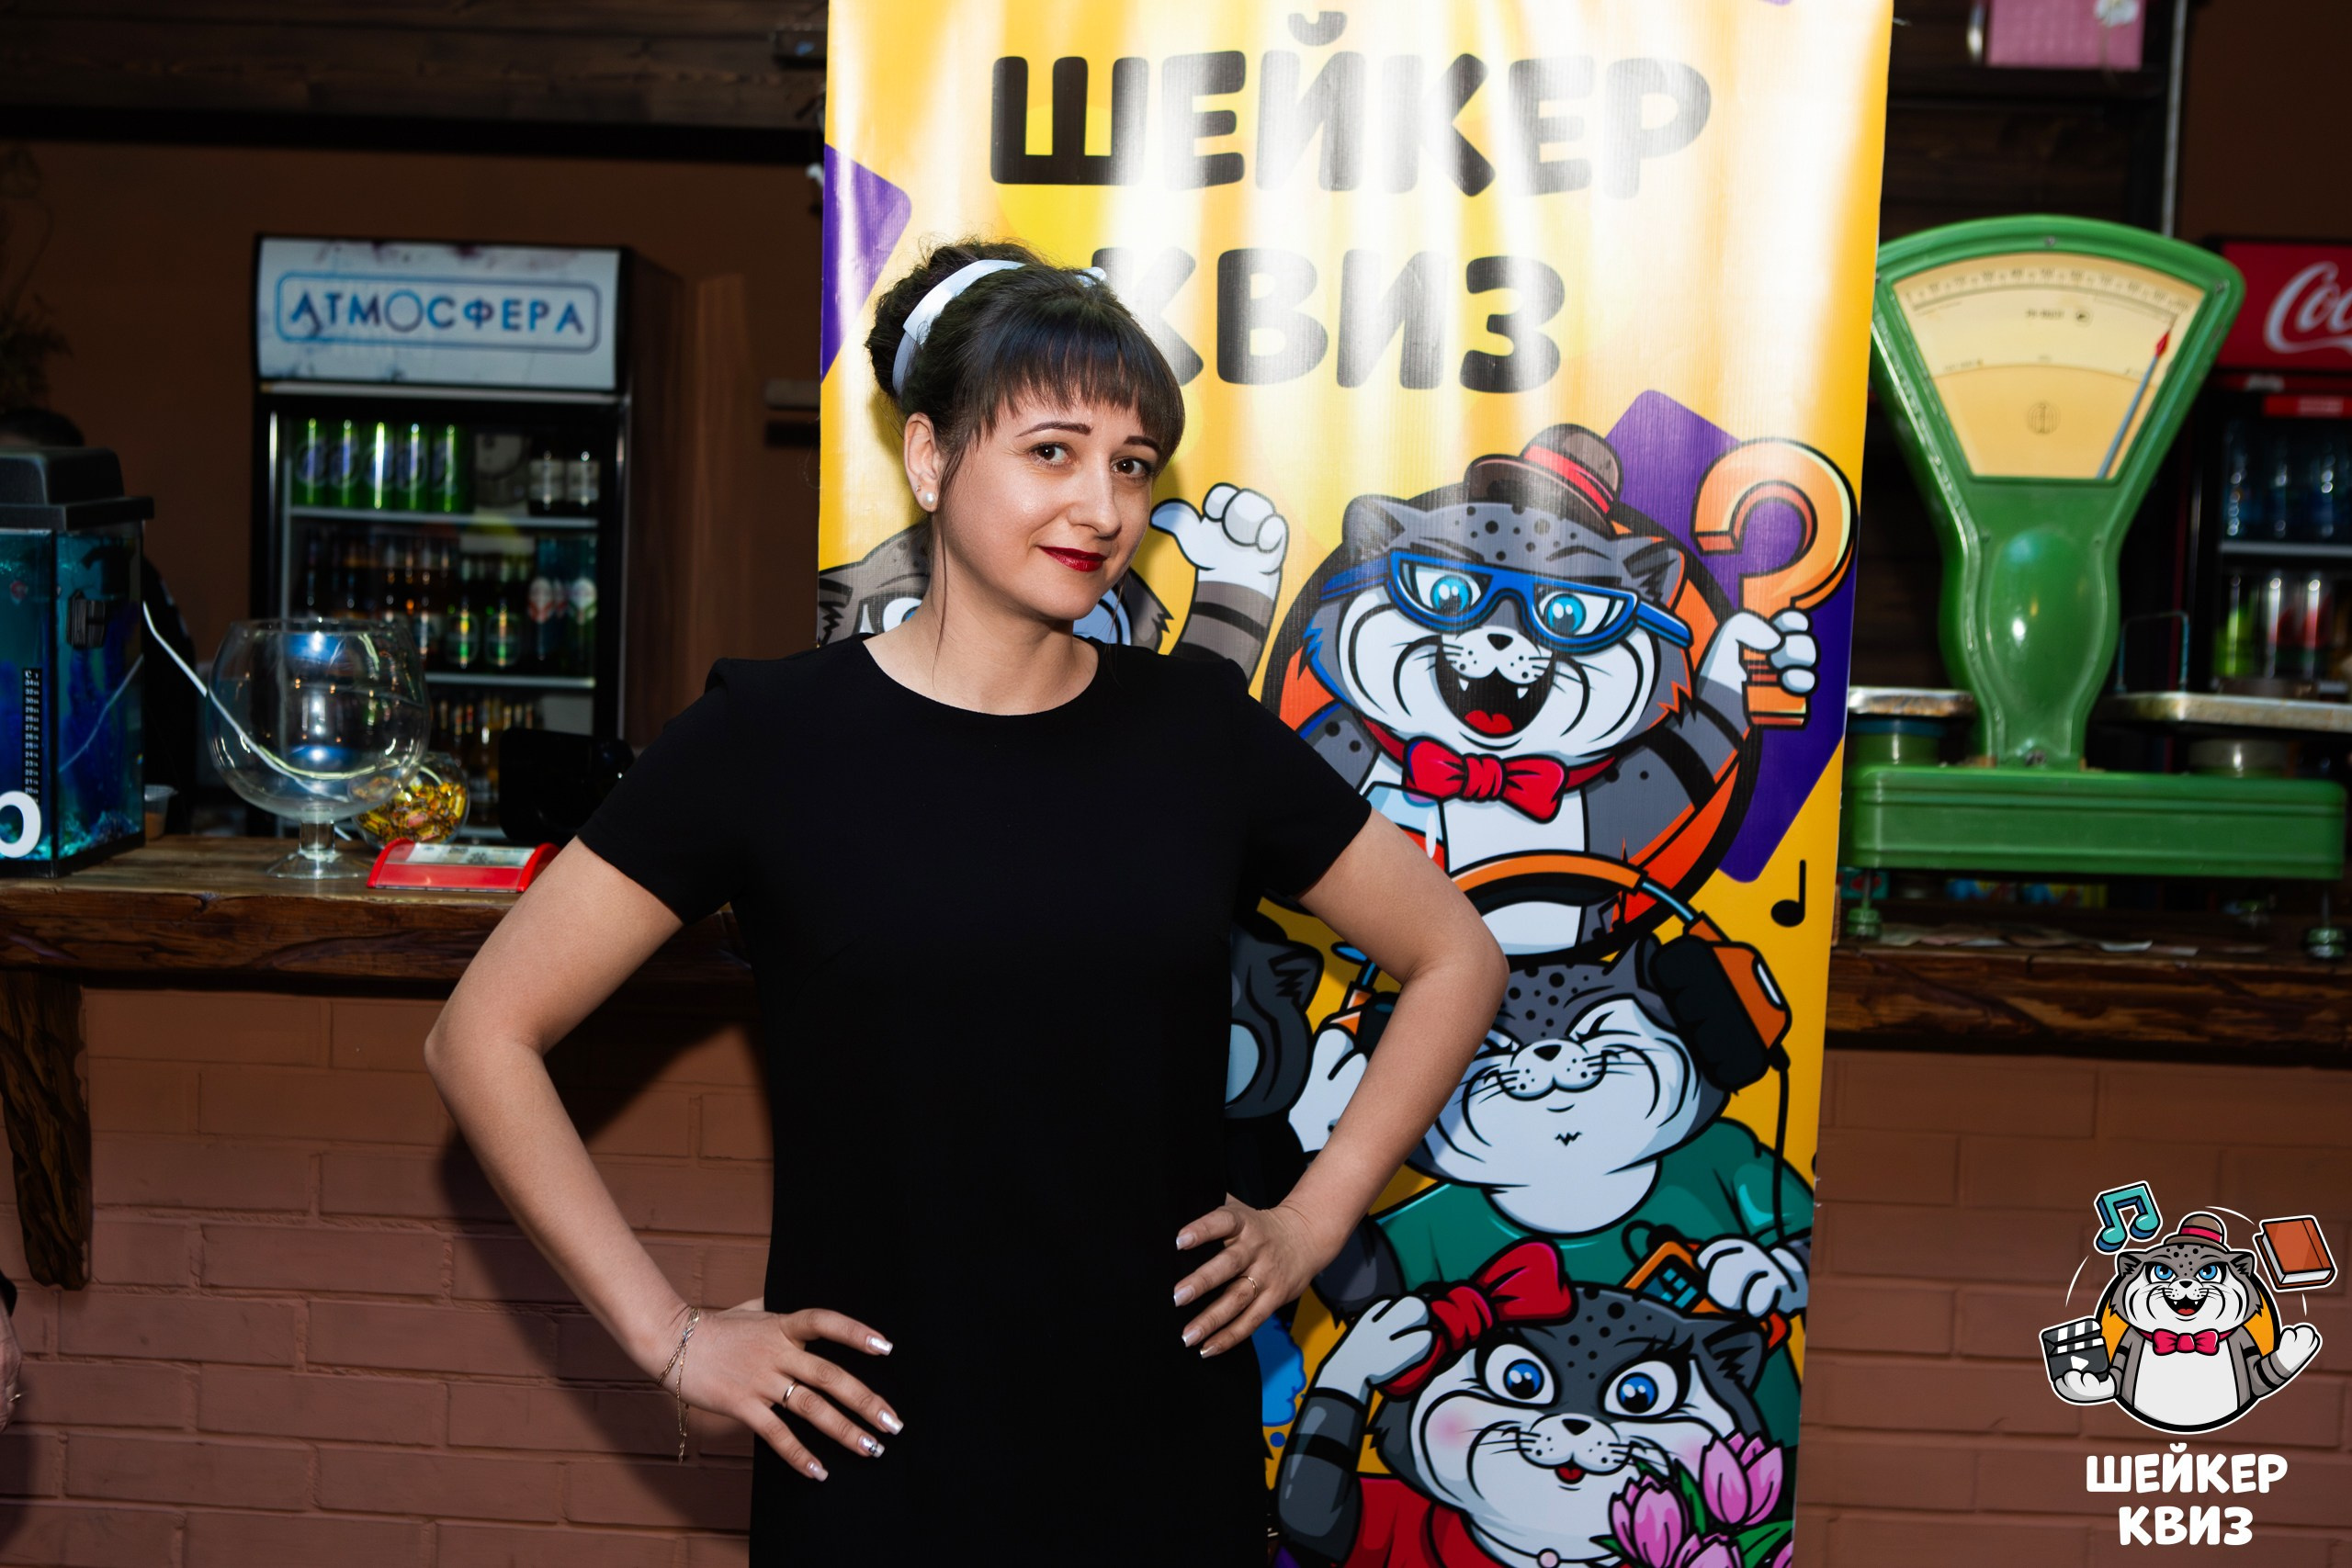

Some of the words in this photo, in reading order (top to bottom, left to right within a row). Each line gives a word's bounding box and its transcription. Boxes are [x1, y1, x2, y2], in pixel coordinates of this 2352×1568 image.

[990, 10, 1712, 198] ШЕЙКЕР
[289, 288, 585, 339] АТМОСФЕРА
[1091, 246, 1566, 394] КВИЗ
